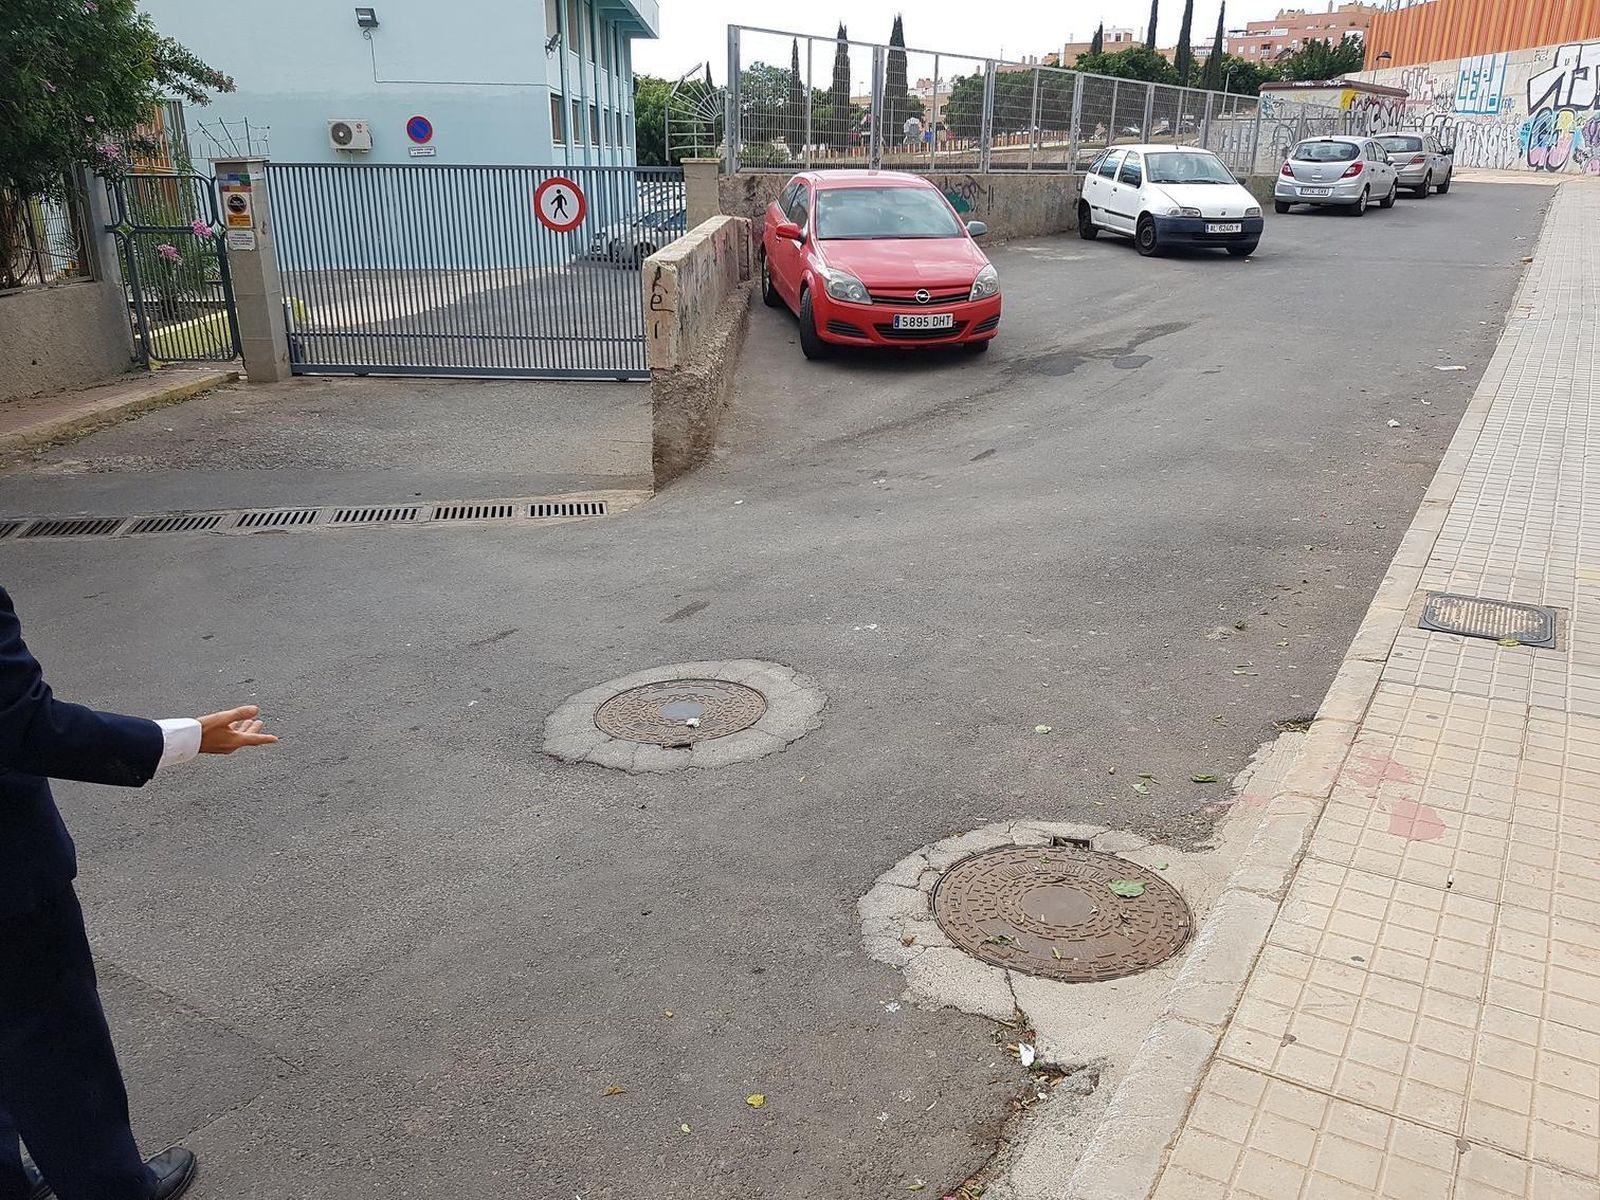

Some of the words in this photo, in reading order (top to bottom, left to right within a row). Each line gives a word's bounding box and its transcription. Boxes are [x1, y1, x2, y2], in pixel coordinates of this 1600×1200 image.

[1218, 224, 1234, 232] 6240
[902, 316, 929, 328] 5895
[932, 315, 951, 327] DHT
